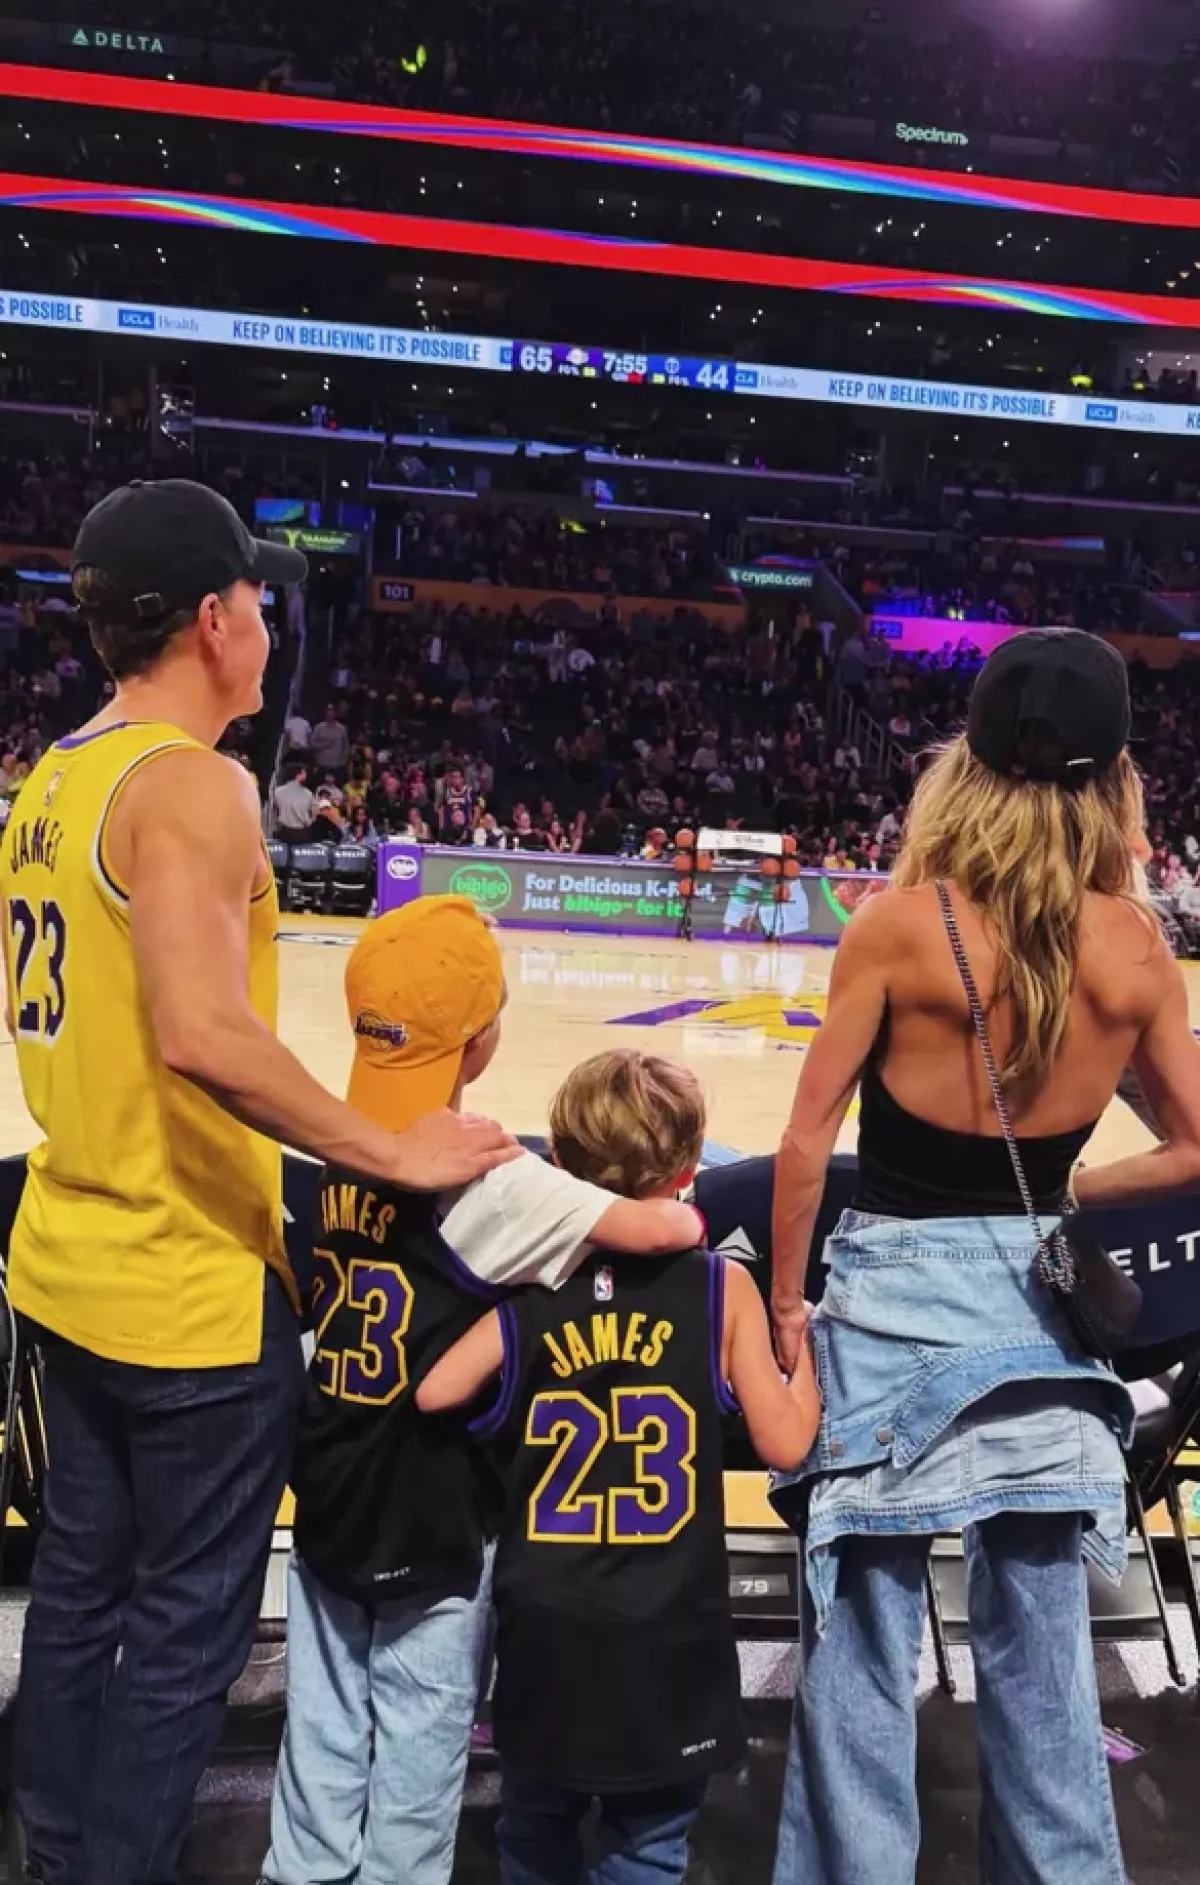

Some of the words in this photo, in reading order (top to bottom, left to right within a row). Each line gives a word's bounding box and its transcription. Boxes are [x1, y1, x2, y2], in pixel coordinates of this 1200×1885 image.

[94, 30, 164, 54] DELTA
[895, 122, 964, 146] Spectrum
[9, 297, 84, 323] POSSIBLE
[158, 314, 200, 333] Health
[233, 319, 270, 341] KEEP
[274, 323, 295, 345] ON
[300, 325, 376, 352] BELIEVING
[379, 334, 407, 355] IT'S
[410, 337, 482, 362] POSSIBLE
[520, 344, 553, 372] 65
[602, 352, 648, 376] 7:55
[695, 362, 729, 390] 44
[828, 378, 864, 399] KEEP
[867, 382, 887, 401] ON
[889, 384, 960, 409] BELIEVING
[963, 391, 988, 412] IT'S
[992, 394, 1058, 418] POSSIBLE
[384, 583, 409, 599] 101
[741, 569, 812, 588] crypto.com
[456, 875, 508, 899] bibigo
[524, 873, 556, 893] For
[559, 873, 643, 896] Delicious
[645, 879, 718, 903] K-Fd,
[522, 892, 561, 912] Just
[636, 897, 664, 916] for
[666, 898, 685, 918] it
[9, 896, 67, 1046] 23
[313, 1246, 415, 1406] 23
[542, 1311, 674, 1379] JAMES
[525, 1385, 697, 1544] 23
[739, 1579, 770, 1595] 79
